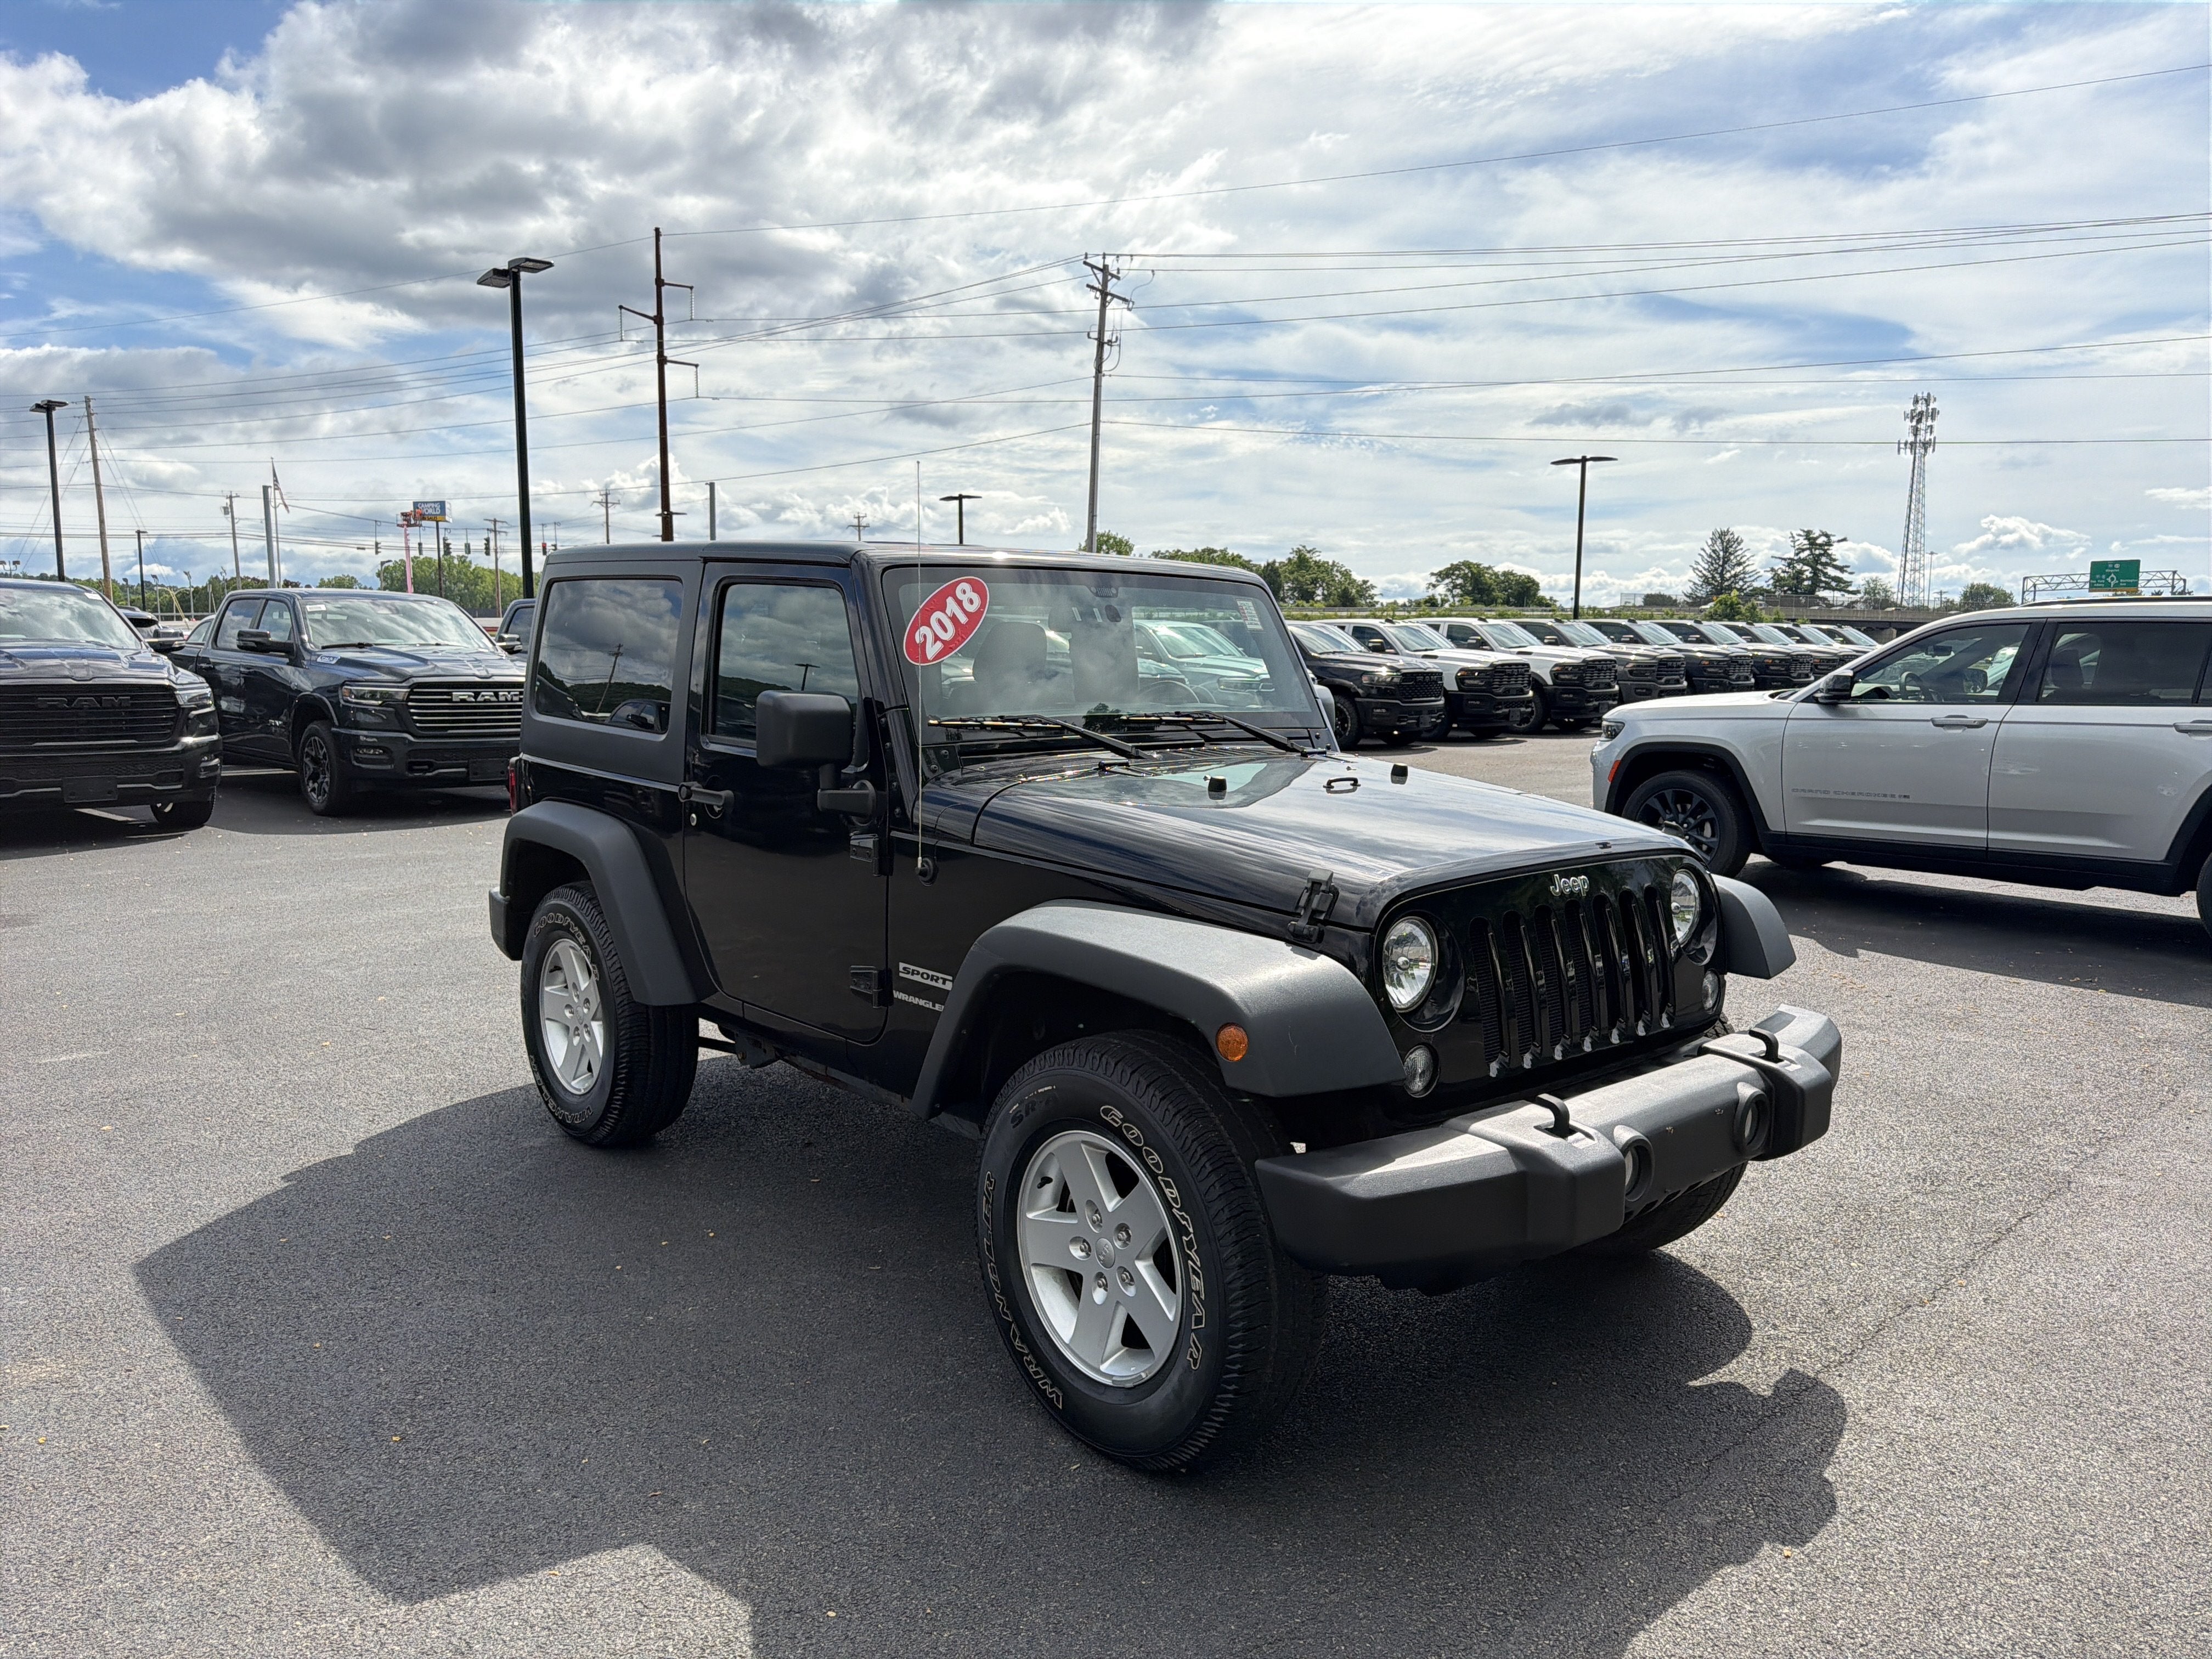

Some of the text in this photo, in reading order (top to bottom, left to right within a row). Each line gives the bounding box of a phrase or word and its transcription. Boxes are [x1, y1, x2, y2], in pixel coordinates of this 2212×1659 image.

[915, 582, 981, 661] 2018
[37, 697, 130, 708] RAM
[452, 691, 520, 702] RAM
[1550, 874, 1590, 896] Jeep
[533, 912, 600, 981] GOODYEAR
[901, 966, 952, 986] SPORT
[893, 990, 945, 1012] WRANGLE
[529, 1054, 593, 1124] WRANGLER
[1100, 1105, 1205, 1370] GOODYEAR
[983, 1171, 1063, 1410] WRANGLER
